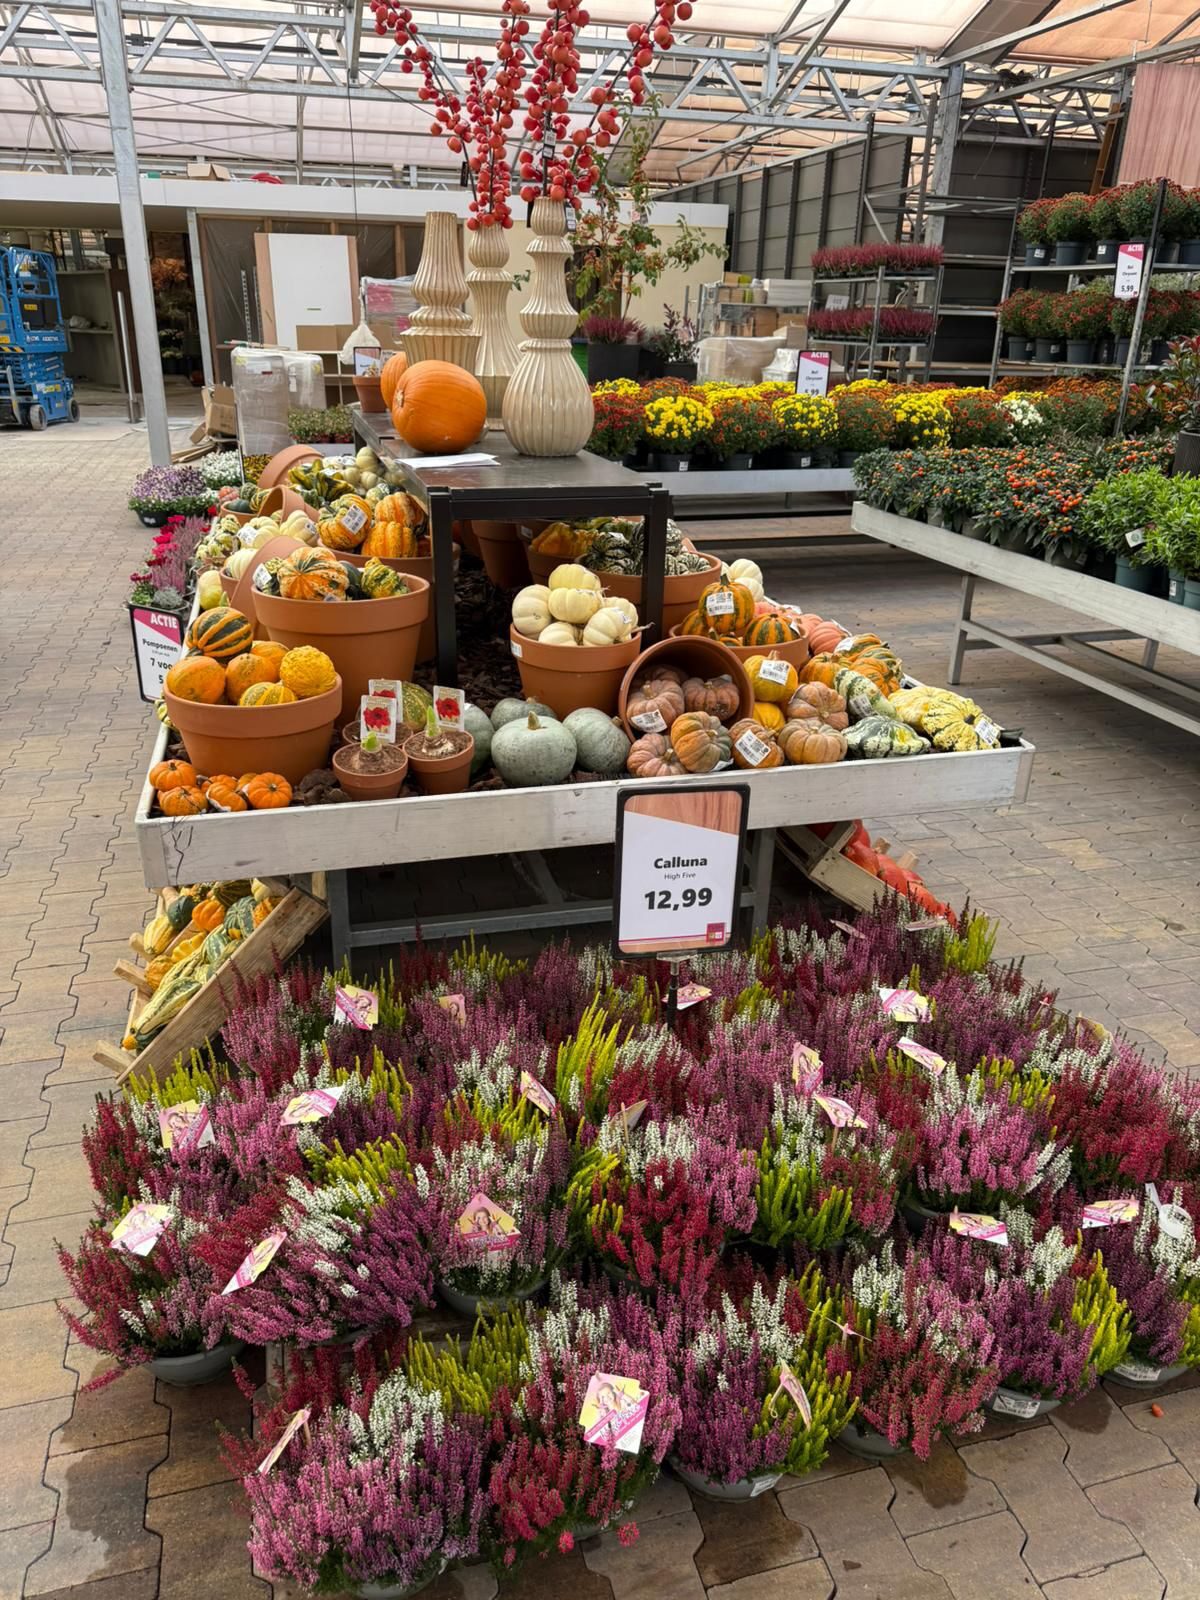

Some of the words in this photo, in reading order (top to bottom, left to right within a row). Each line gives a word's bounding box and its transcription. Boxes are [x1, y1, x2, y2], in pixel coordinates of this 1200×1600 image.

[1121, 285, 1134, 293] 5,99
[150, 613, 178, 629] ACTIE
[142, 638, 178, 652] Pompoenen
[150, 657, 155, 666] 7
[654, 857, 708, 869] Calluna
[644, 888, 713, 911] 12,99
